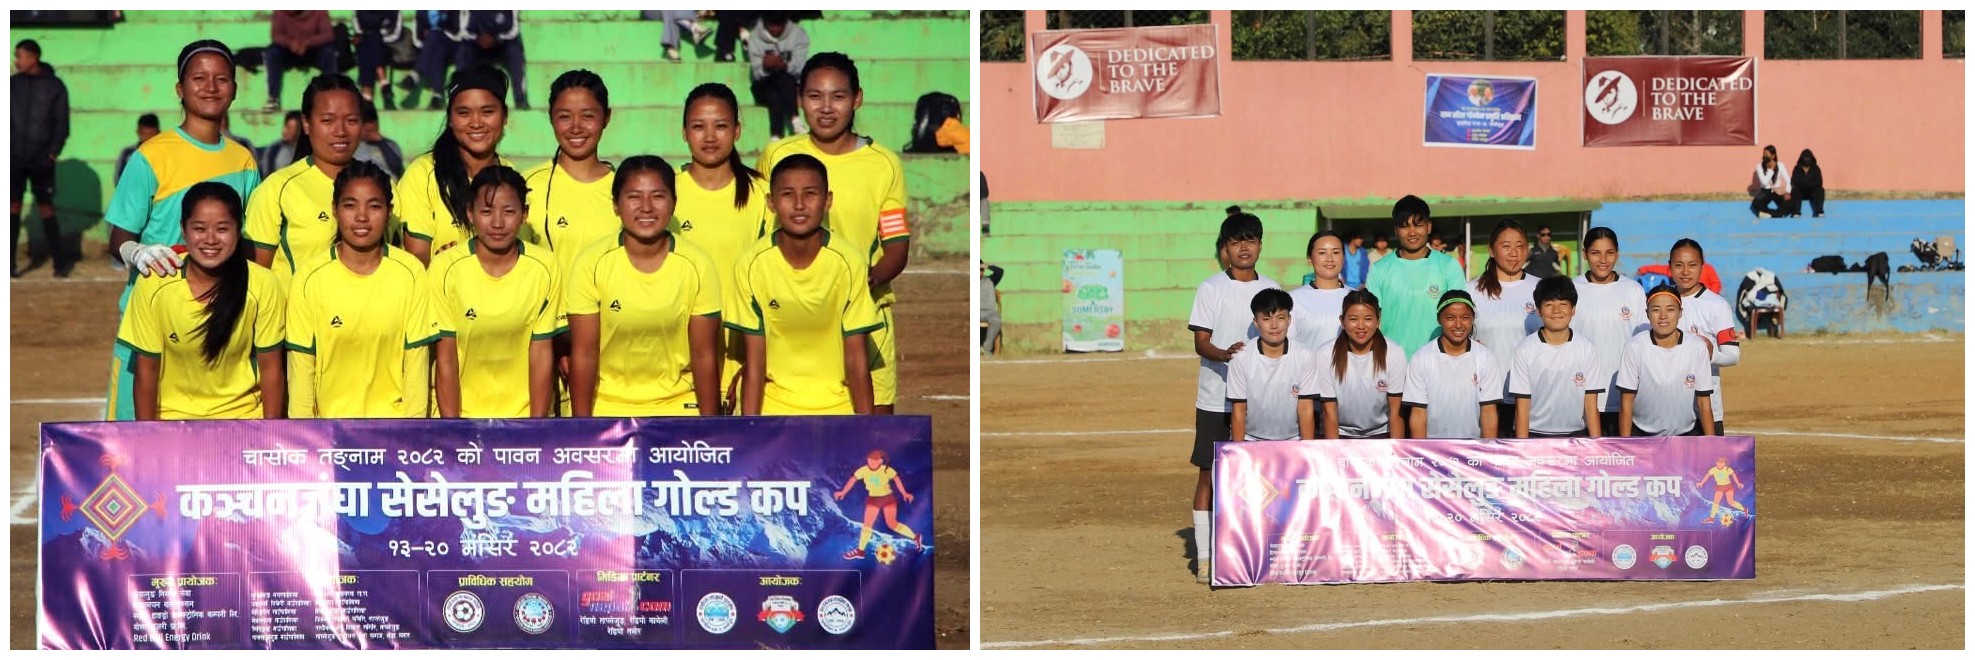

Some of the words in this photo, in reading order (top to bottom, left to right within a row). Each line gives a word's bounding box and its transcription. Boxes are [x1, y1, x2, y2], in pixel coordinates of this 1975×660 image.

[1107, 45, 1215, 64] DEDICATED
[1107, 64, 1135, 78] TO
[1138, 62, 1178, 77] THE
[1109, 77, 1166, 94] BRAVE
[1652, 77, 1752, 91] DEDICATED
[1651, 92, 1676, 106] TO
[1681, 92, 1717, 106] THE
[1652, 107, 1704, 121] BRAVE
[242, 443, 308, 466] चासोक
[397, 449, 445, 465] २०८२
[456, 441, 482, 466] को
[492, 447, 542, 465] पावन
[552, 446, 640, 465] अवसरमा
[649, 440, 734, 465] आयोजित
[1584, 451, 1636, 467] आयोजित
[1586, 469, 1641, 498] गोल्ड
[1644, 475, 1682, 498] कप
[521, 469, 647, 517] महिला
[652, 469, 742, 516] गोल्ड
[747, 480, 810, 516] कप
[529, 539, 579, 557] २०८२
[458, 574, 496, 587] प्राविधिक
[499, 574, 534, 587] सहयोग
[632, 570, 661, 582] पार्टनर
[133, 634, 148, 643] Red
[165, 633, 191, 643] Energy
[191, 632, 211, 641] Drink
